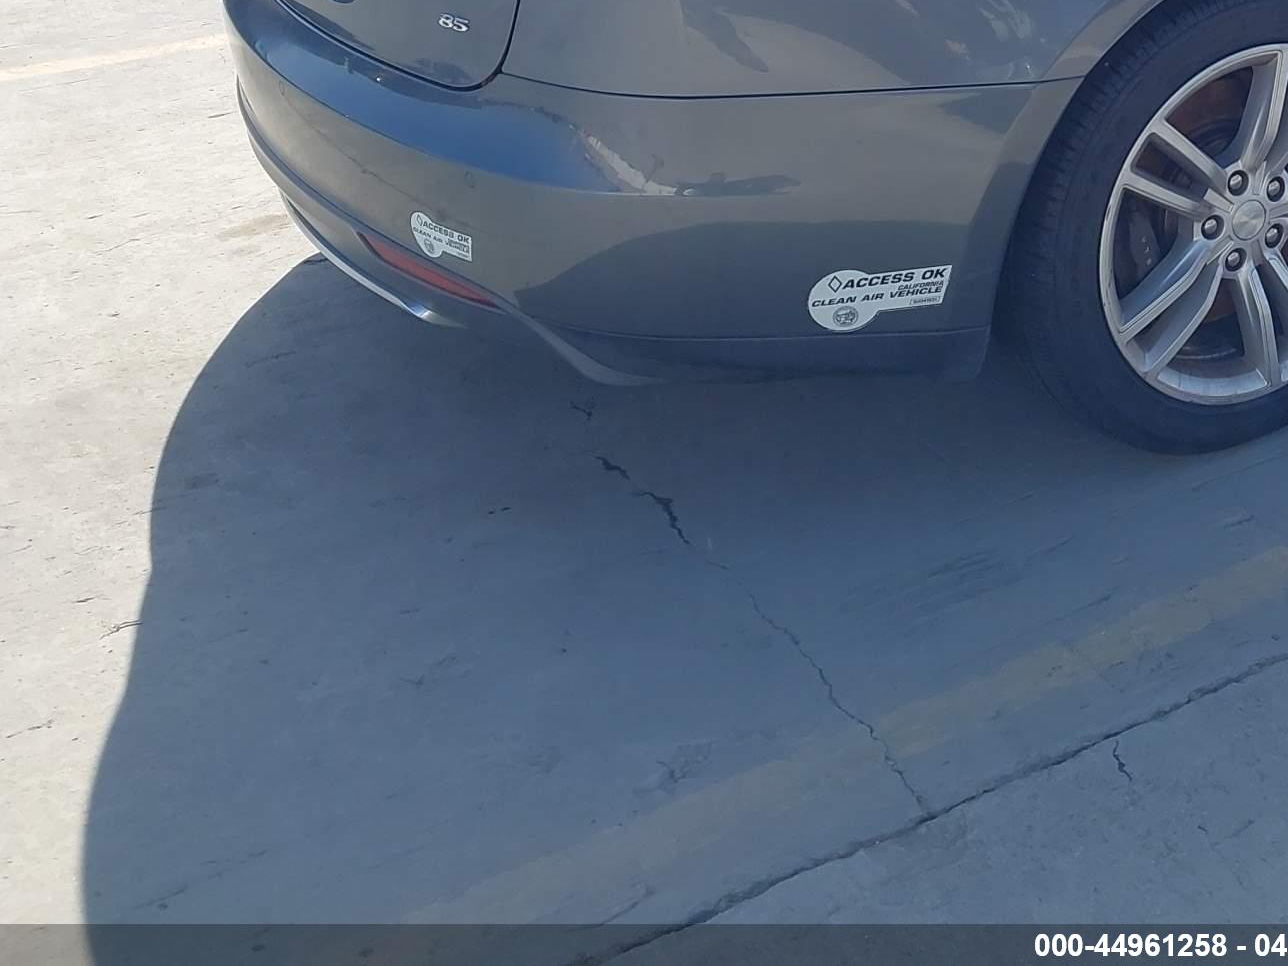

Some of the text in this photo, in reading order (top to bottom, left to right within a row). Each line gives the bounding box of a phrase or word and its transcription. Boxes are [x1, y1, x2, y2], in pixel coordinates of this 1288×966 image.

[438, 13, 469, 32] 85
[423, 221, 454, 239] ACCESS
[457, 234, 470, 244] OK
[842, 267, 947, 290] ACCESS OK
[898, 280, 944, 291] CALIFORNIA
[812, 286, 942, 307] CLEAN AIR VEHICLE
